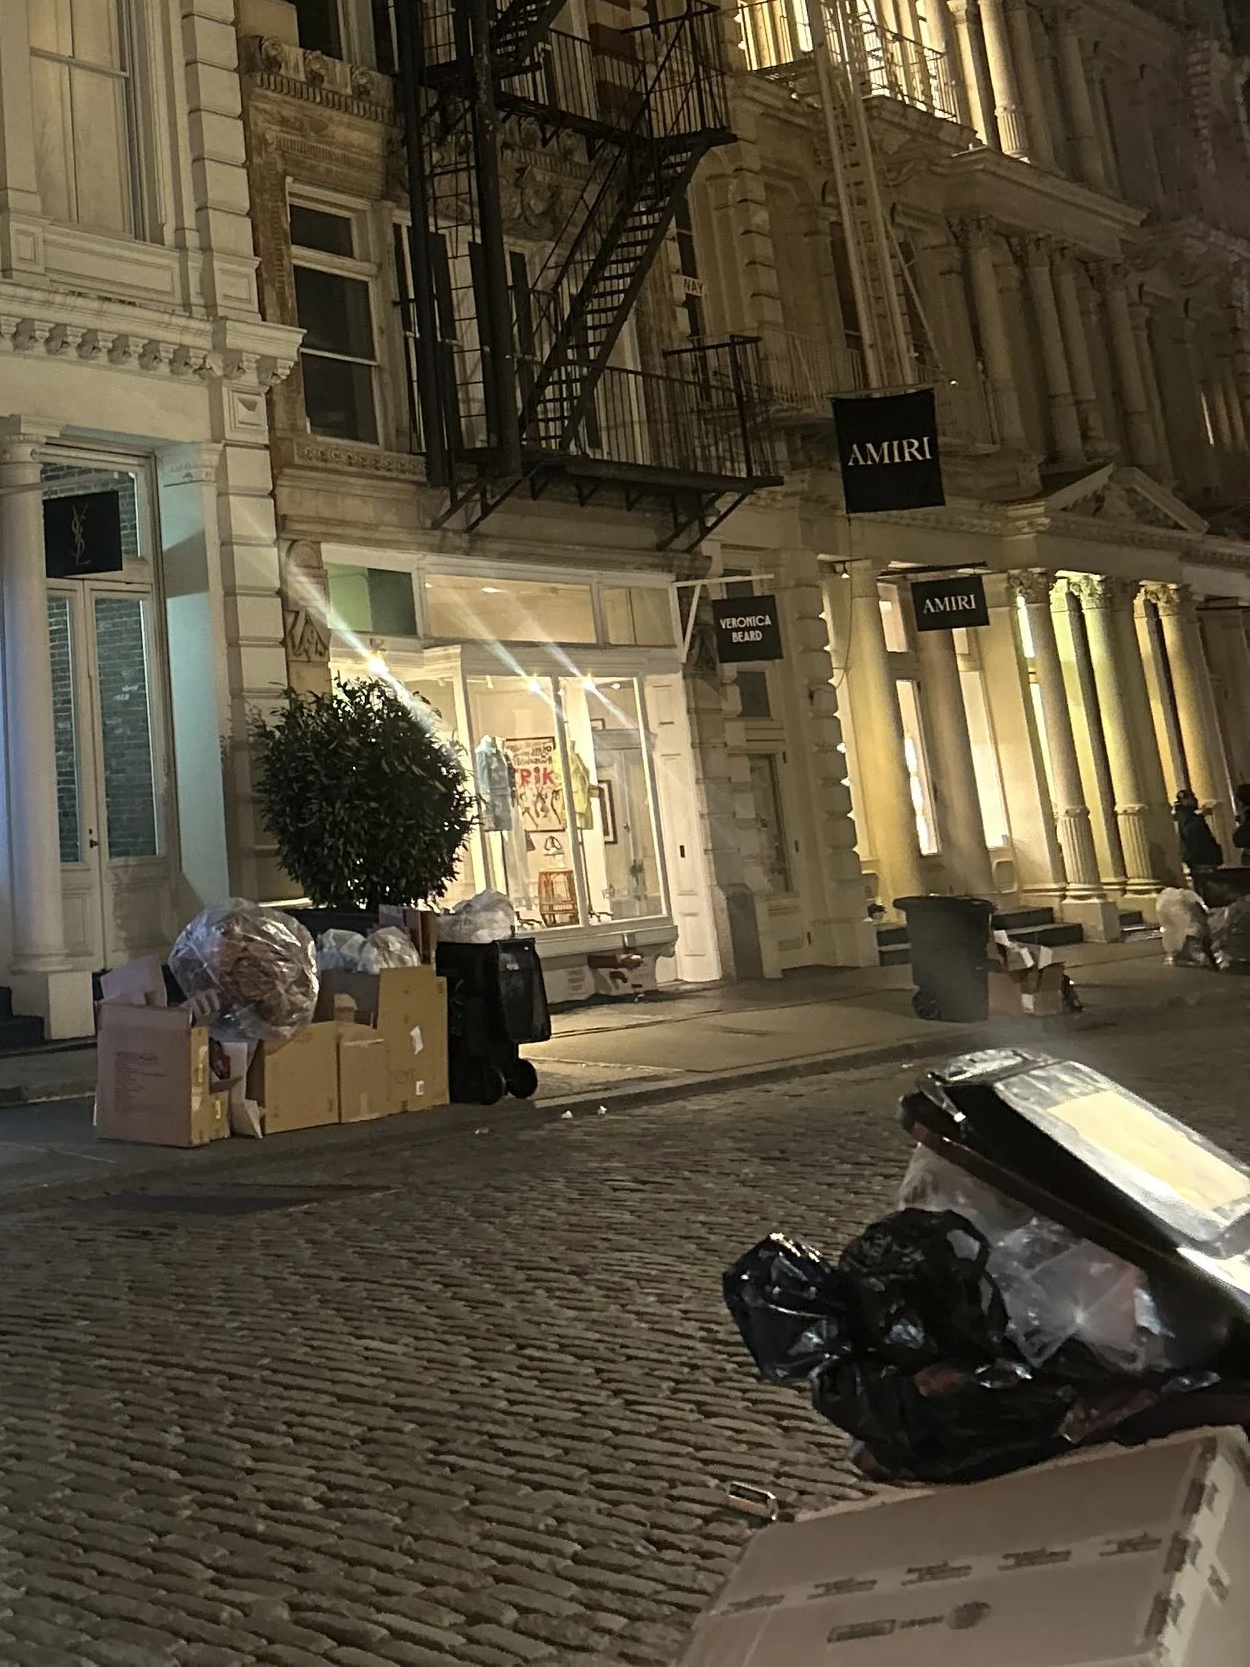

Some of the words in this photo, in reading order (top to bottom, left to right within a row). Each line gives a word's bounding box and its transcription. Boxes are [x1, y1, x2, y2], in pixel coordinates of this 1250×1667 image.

[848, 436, 934, 466] AMIRI
[923, 594, 977, 614] AMIRI
[720, 615, 772, 629] VERONICA
[732, 630, 763, 643] BEARD
